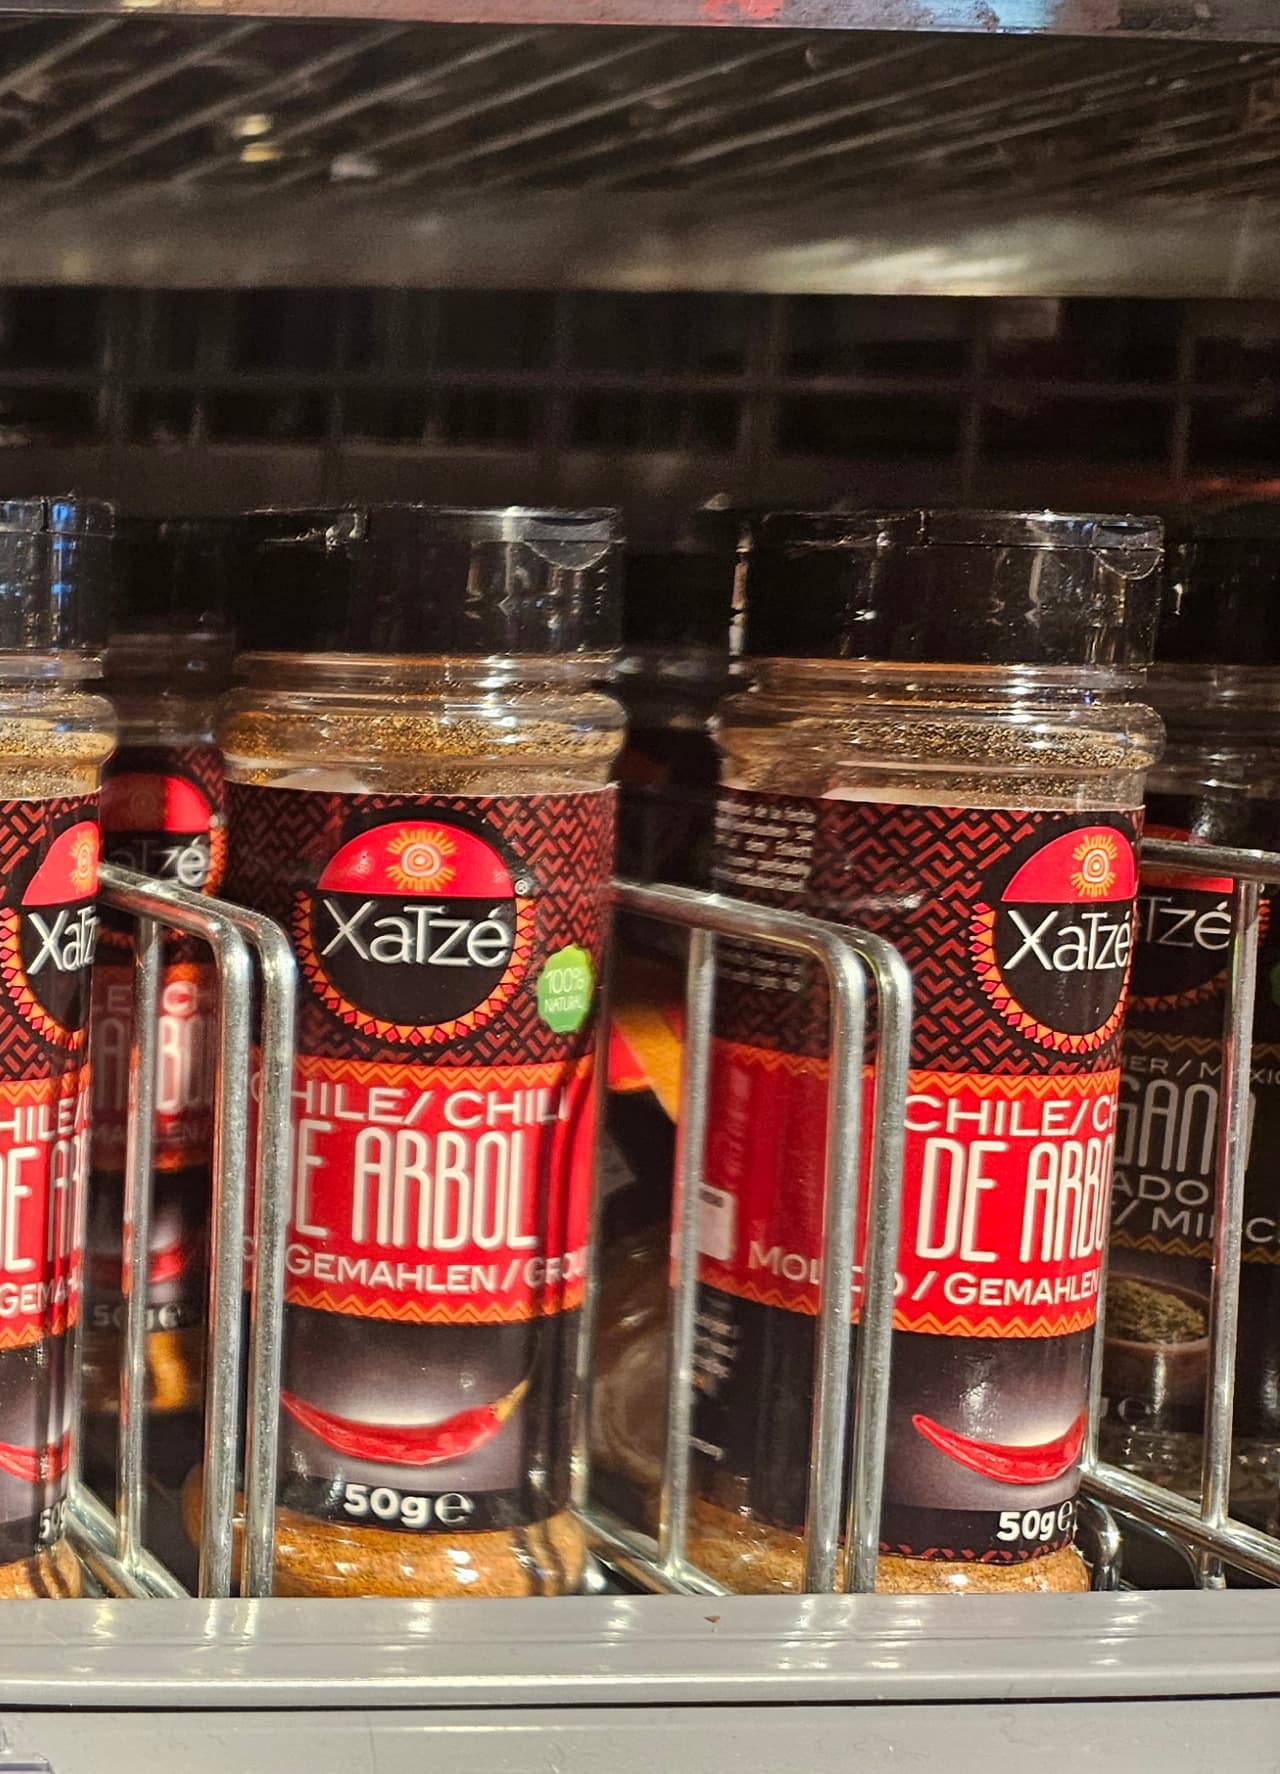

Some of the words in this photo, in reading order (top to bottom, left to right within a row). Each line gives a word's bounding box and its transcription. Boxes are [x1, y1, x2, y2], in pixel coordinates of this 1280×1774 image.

[352, 1127, 537, 1251] ARBOL
[916, 1138, 1007, 1263] DE
[1019, 1133, 1115, 1263] ARBO
[284, 1241, 499, 1294] GEMAHLEN
